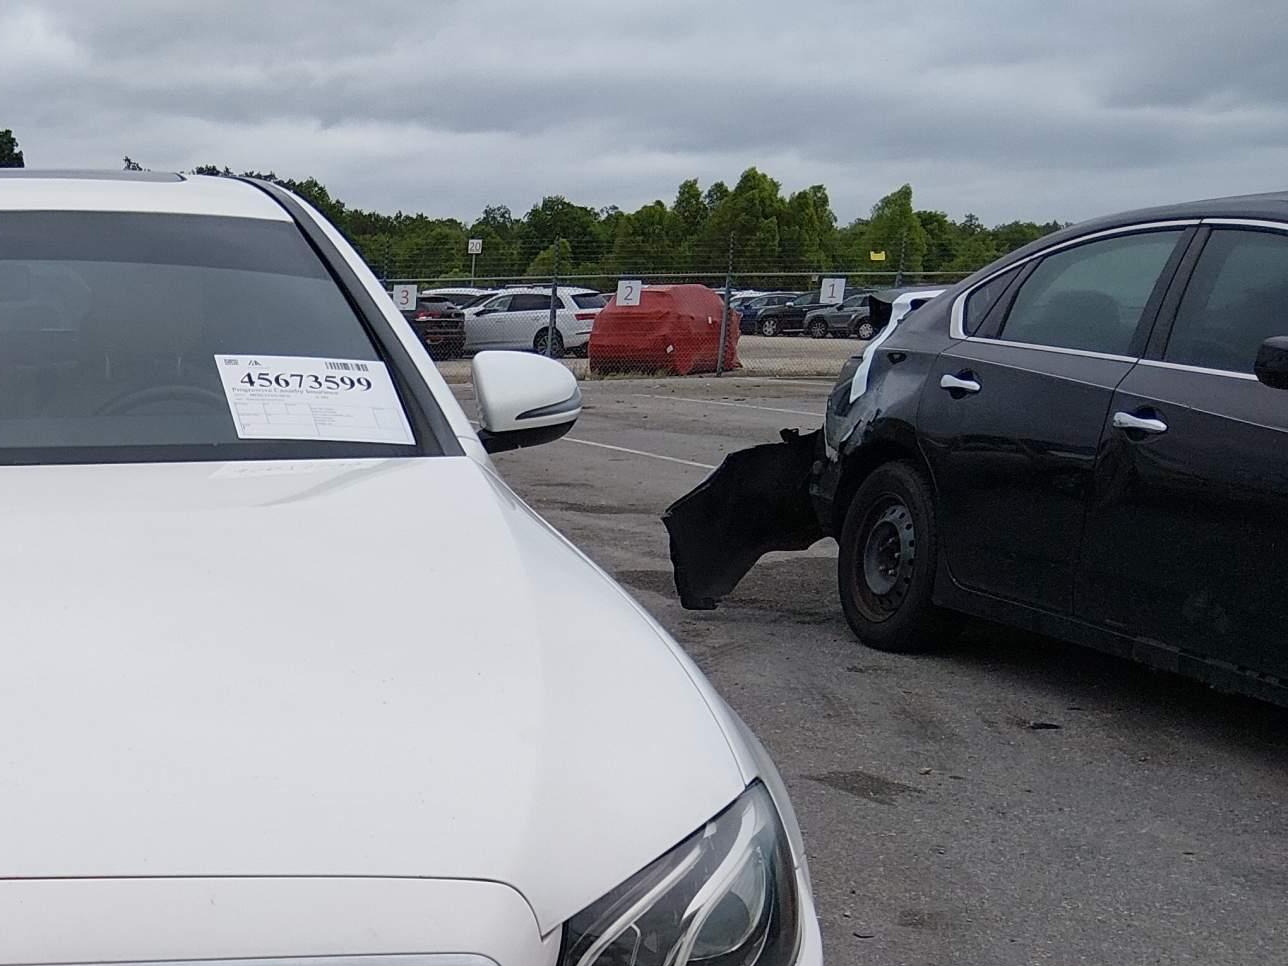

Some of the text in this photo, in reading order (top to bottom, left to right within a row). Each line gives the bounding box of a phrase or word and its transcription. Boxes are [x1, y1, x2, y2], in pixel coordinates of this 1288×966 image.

[470, 242, 481, 252] 20
[399, 289, 409, 305] 3
[623, 285, 633, 301] 2
[827, 283, 837, 299] 1
[240, 372, 372, 392] 45673599
